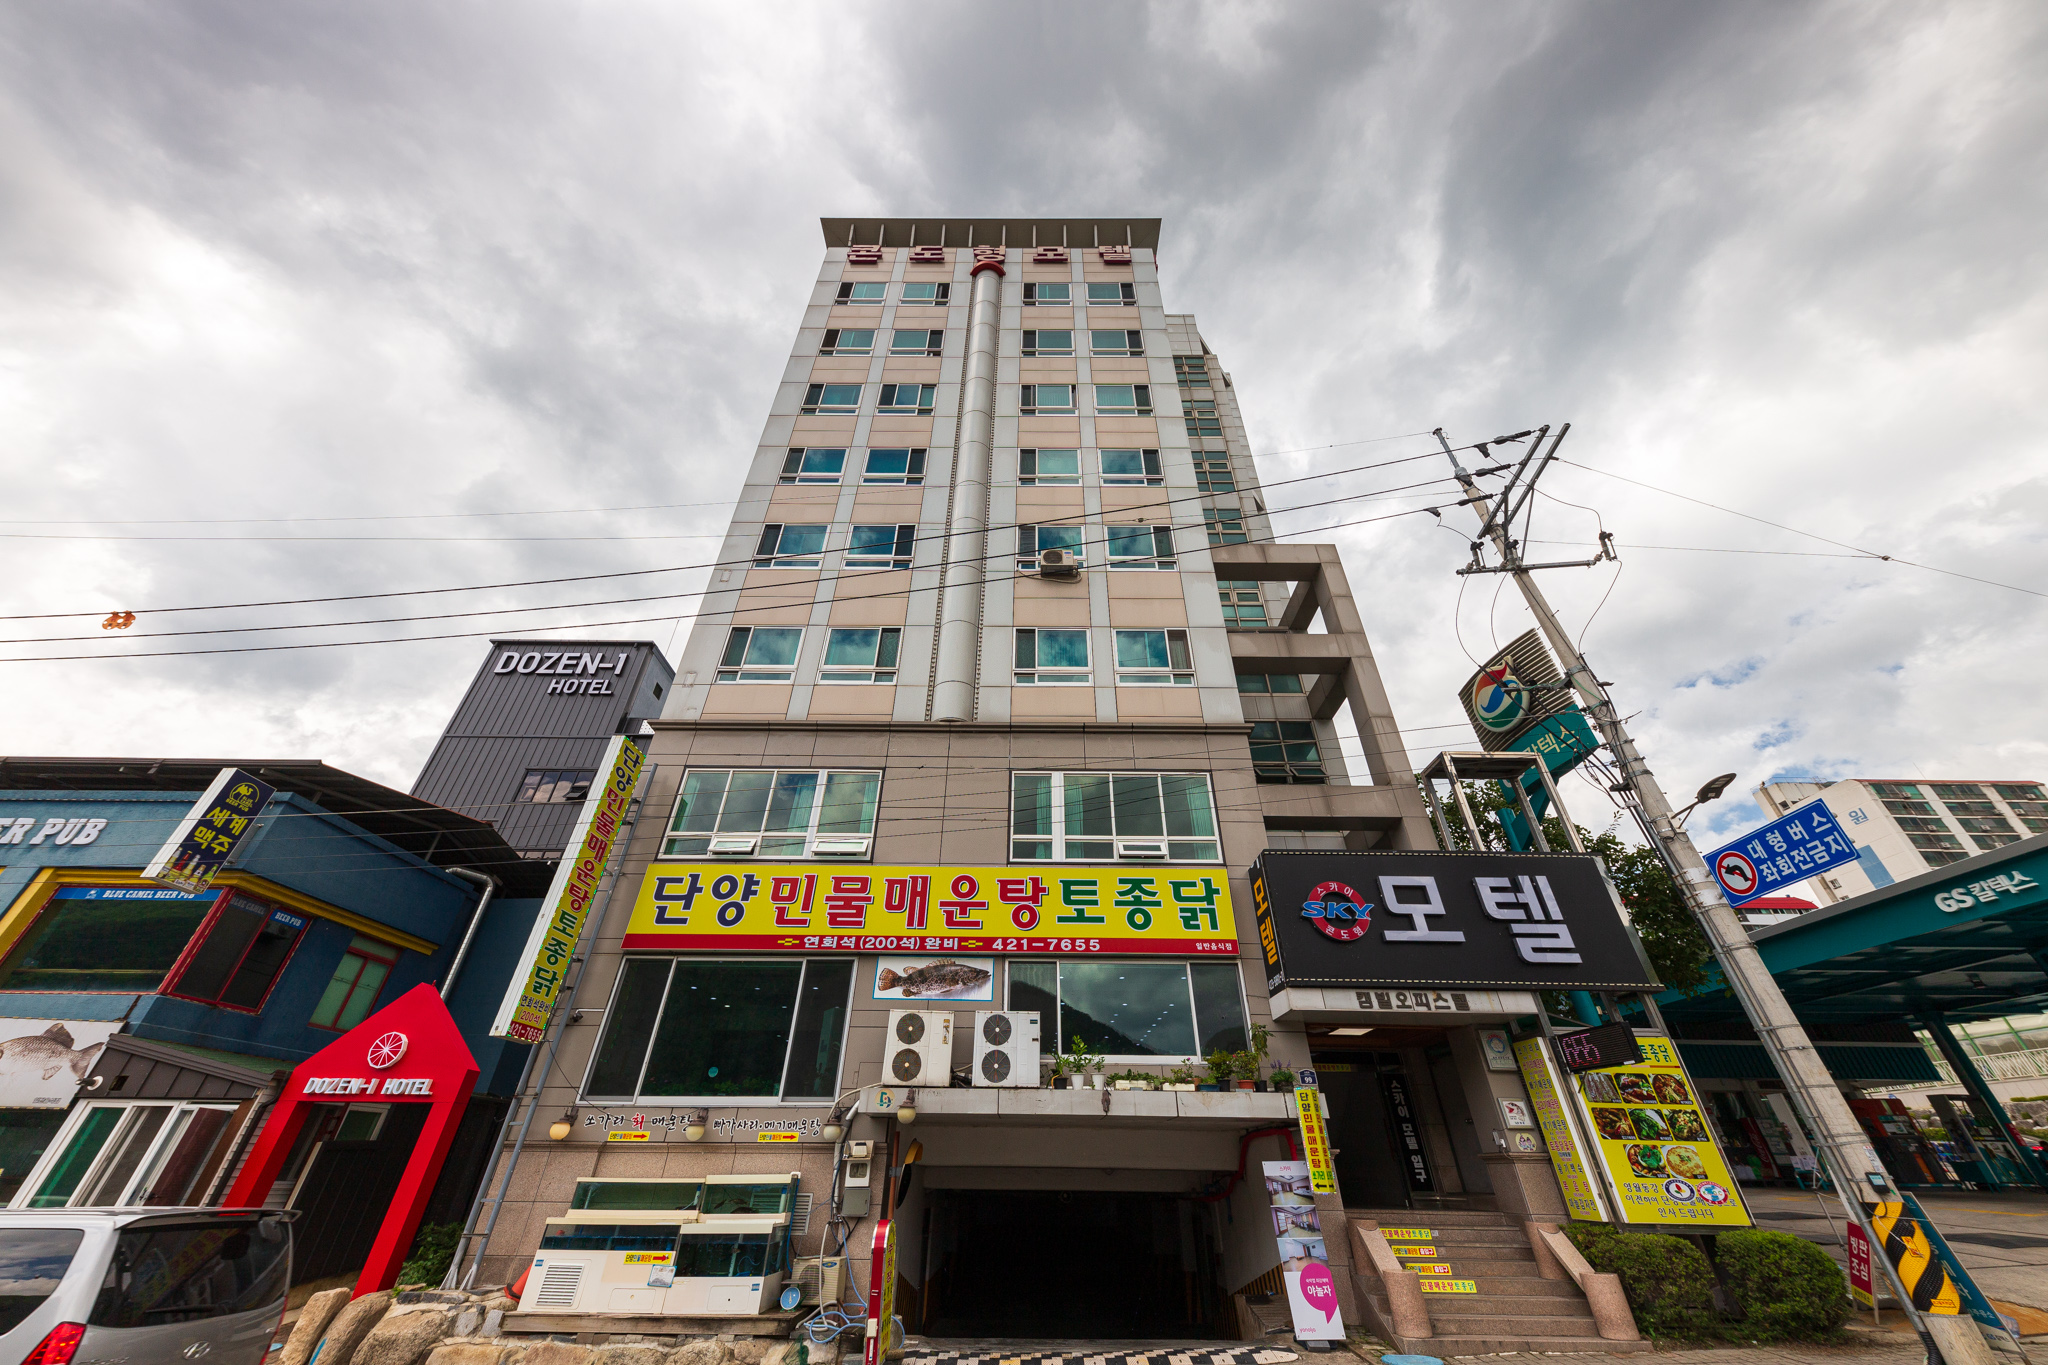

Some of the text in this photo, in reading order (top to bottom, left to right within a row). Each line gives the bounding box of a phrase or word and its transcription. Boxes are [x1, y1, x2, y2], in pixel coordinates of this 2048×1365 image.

[546, 678, 613, 696] HOTEL
[238, 803, 250, 812] PUB
[206, 806, 249, 836] 세계
[29, 818, 108, 845] PUB
[193, 826, 233, 855] 맥주
[1759, 831, 1850, 882] 좌회전금지
[102, 890, 196, 900] BLUE CAMEL BEER PUB
[1317, 882, 1354, 897] 스카이
[275, 912, 302, 927] BEER PUB
[1301, 900, 1375, 920] SKY
[1377, 875, 1583, 964] 모텔
[1253, 877, 1278, 966] 모텔
[1325, 924, 1364, 940] 콘도형
[992, 938, 1101, 951] 421-7655
[1195, 942, 1232, 951] 일반음식점
[508, 1021, 541, 1042] 421-7655
[380, 1078, 434, 1095] HOTEL
[1304, 1076, 1313, 1084] 99
[584, 1112, 694, 1132] 쏘가리 회 매운탕
[1391, 1080, 1427, 1183] 스카이 모텔 입구
[1657, 1207, 1677, 1218] 인사
[1850, 1235, 1868, 1259] 빙판
[1851, 1257, 1869, 1282] 조심
[1307, 1284, 1332, 1297] 야놀자
